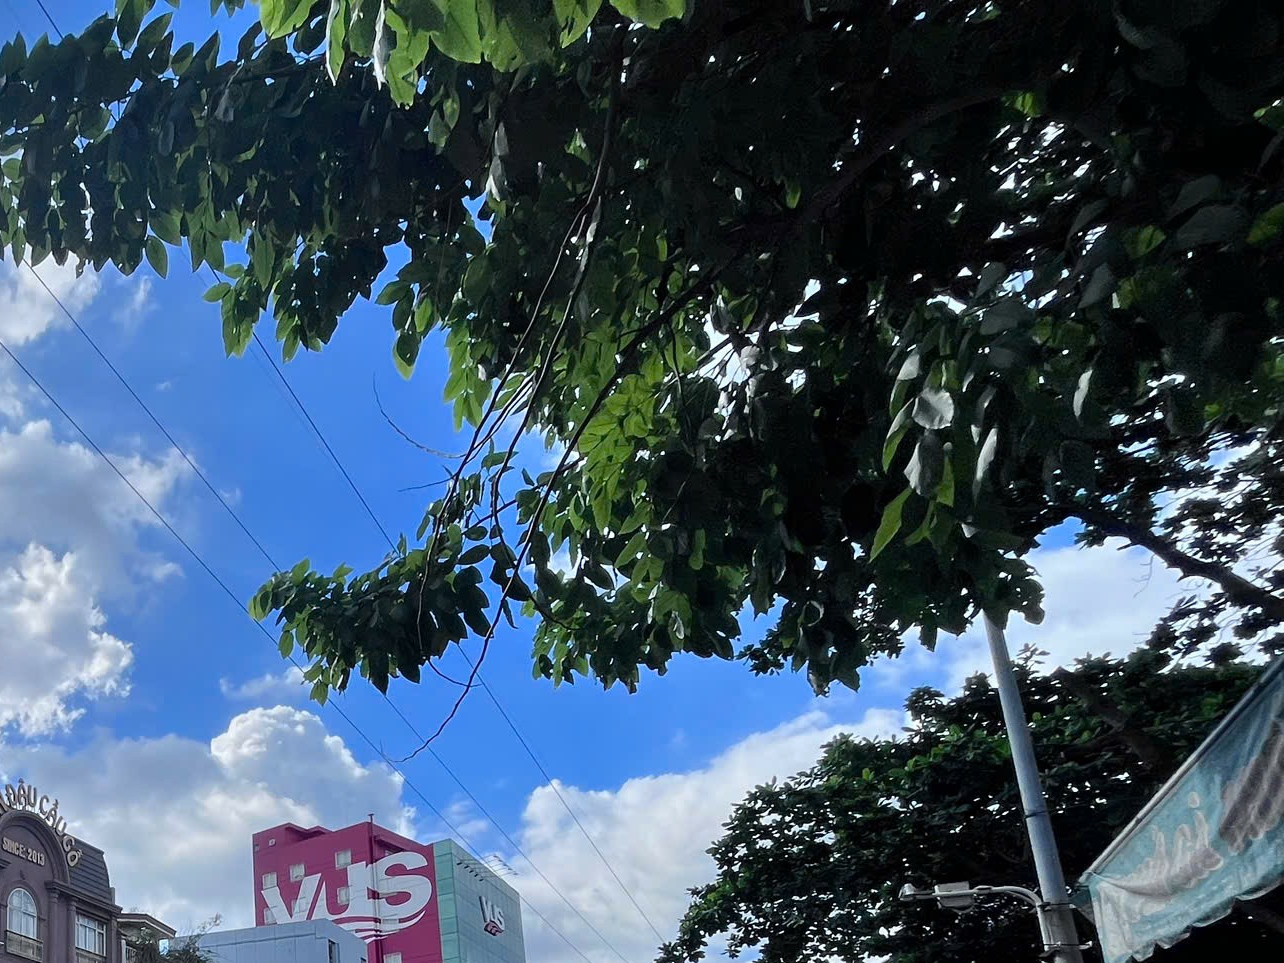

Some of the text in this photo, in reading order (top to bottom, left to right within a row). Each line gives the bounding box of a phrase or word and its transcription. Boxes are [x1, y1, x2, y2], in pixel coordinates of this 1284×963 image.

[27, 848, 46, 867] 2013
[261, 851, 432, 925] VUS
[479, 895, 505, 930] VUS
